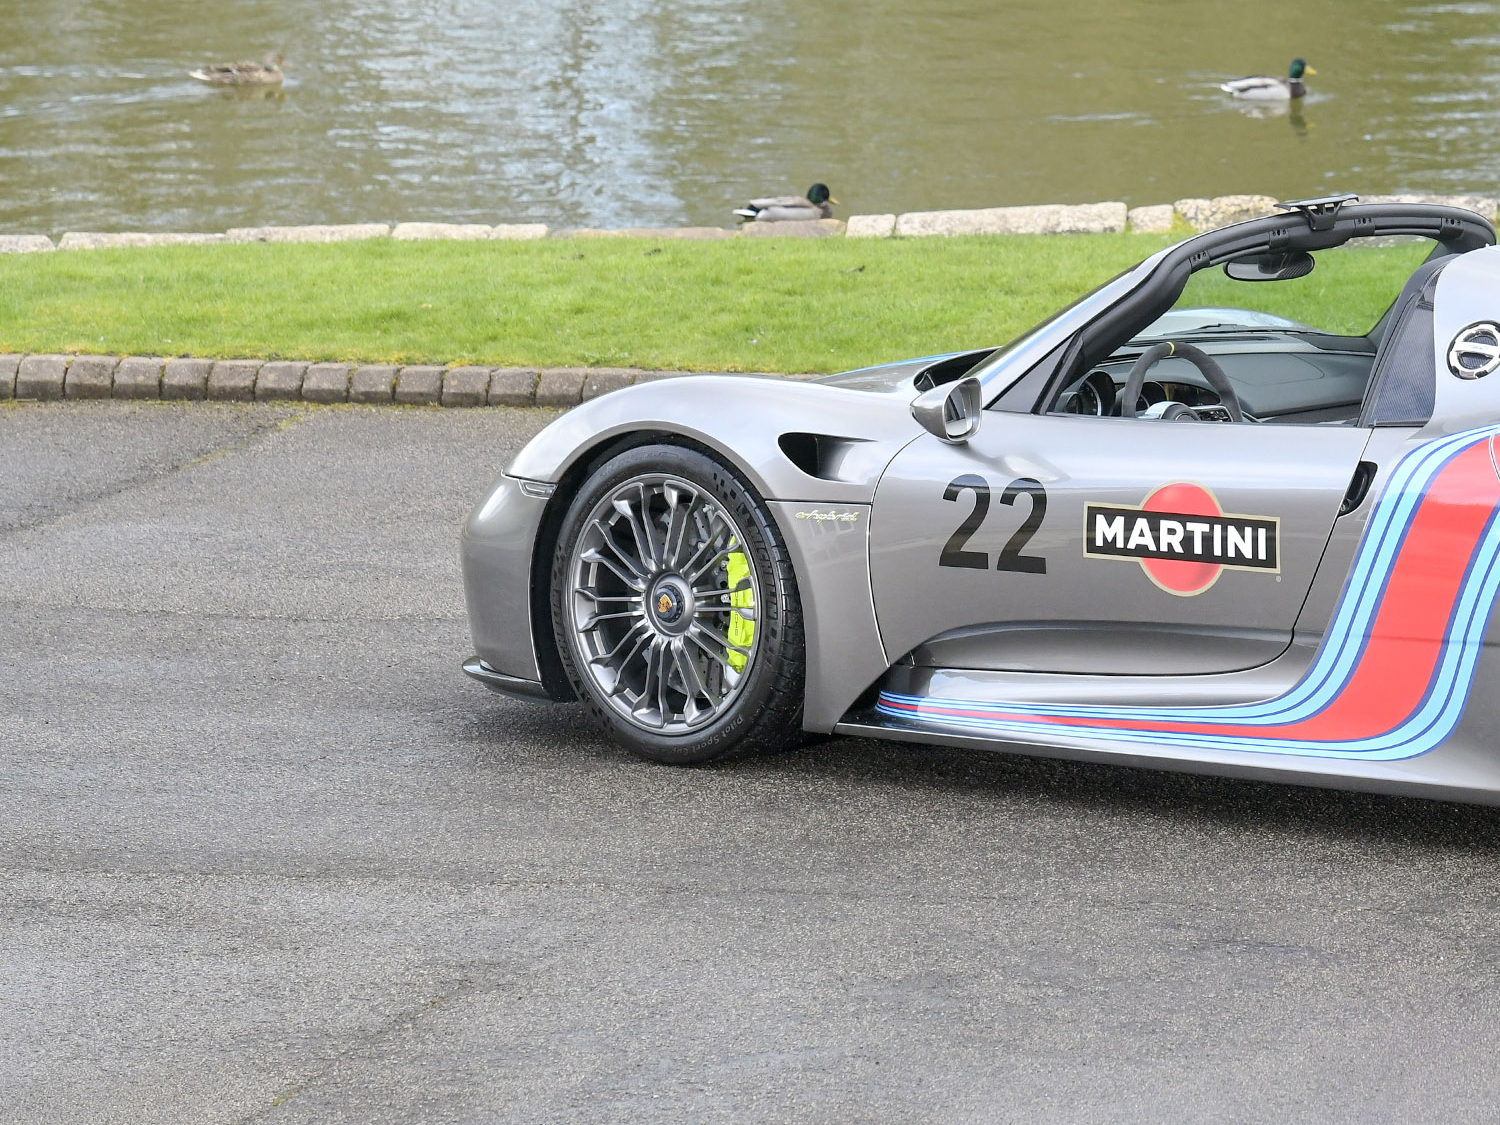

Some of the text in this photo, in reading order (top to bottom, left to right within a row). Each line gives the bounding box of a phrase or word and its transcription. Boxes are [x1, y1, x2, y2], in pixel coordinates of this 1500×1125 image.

[938, 473, 1048, 575] 22
[1095, 513, 1267, 561] MARTINI
[691, 732, 720, 754] Sport
[721, 715, 744, 738] Pilot
